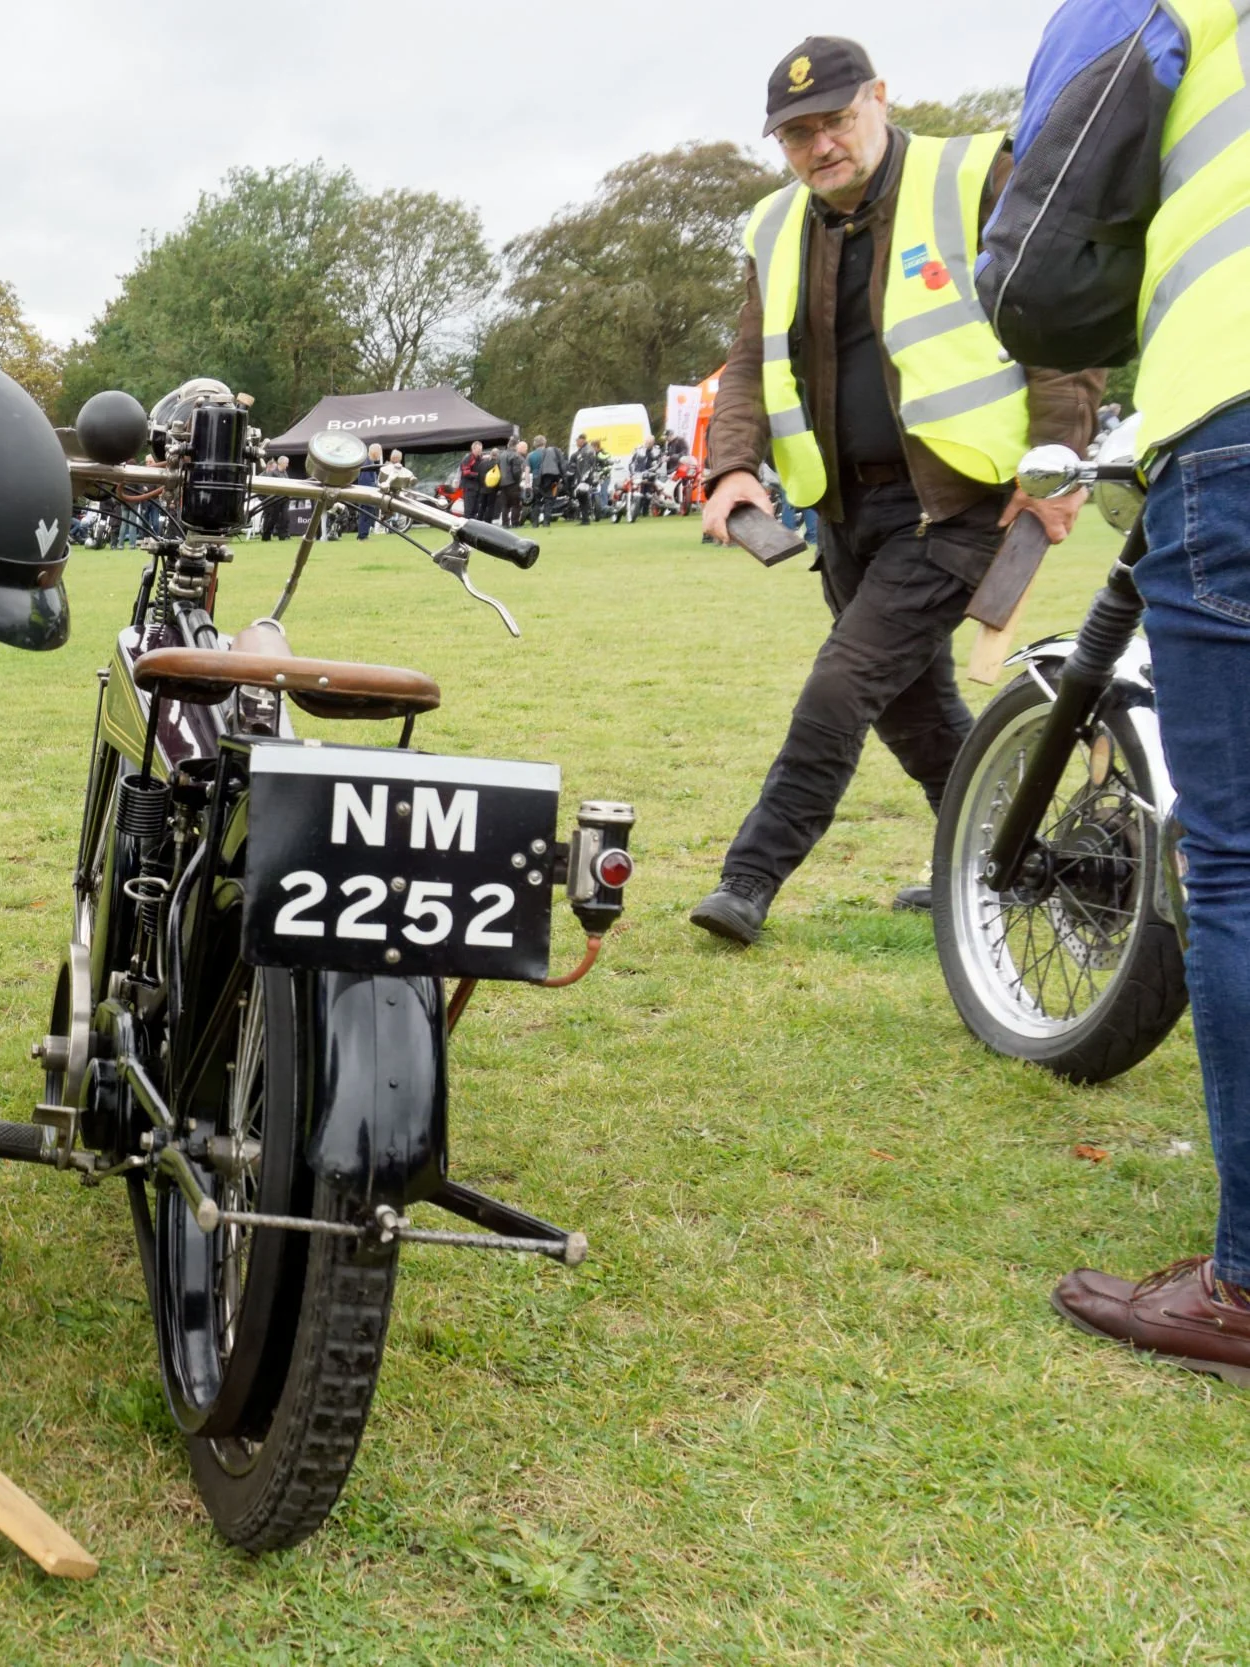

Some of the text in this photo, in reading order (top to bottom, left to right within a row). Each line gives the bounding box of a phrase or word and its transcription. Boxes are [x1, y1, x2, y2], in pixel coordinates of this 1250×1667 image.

[327, 413, 438, 430] Bonhams
[331, 783, 478, 852] NM
[274, 870, 515, 948] 2252
